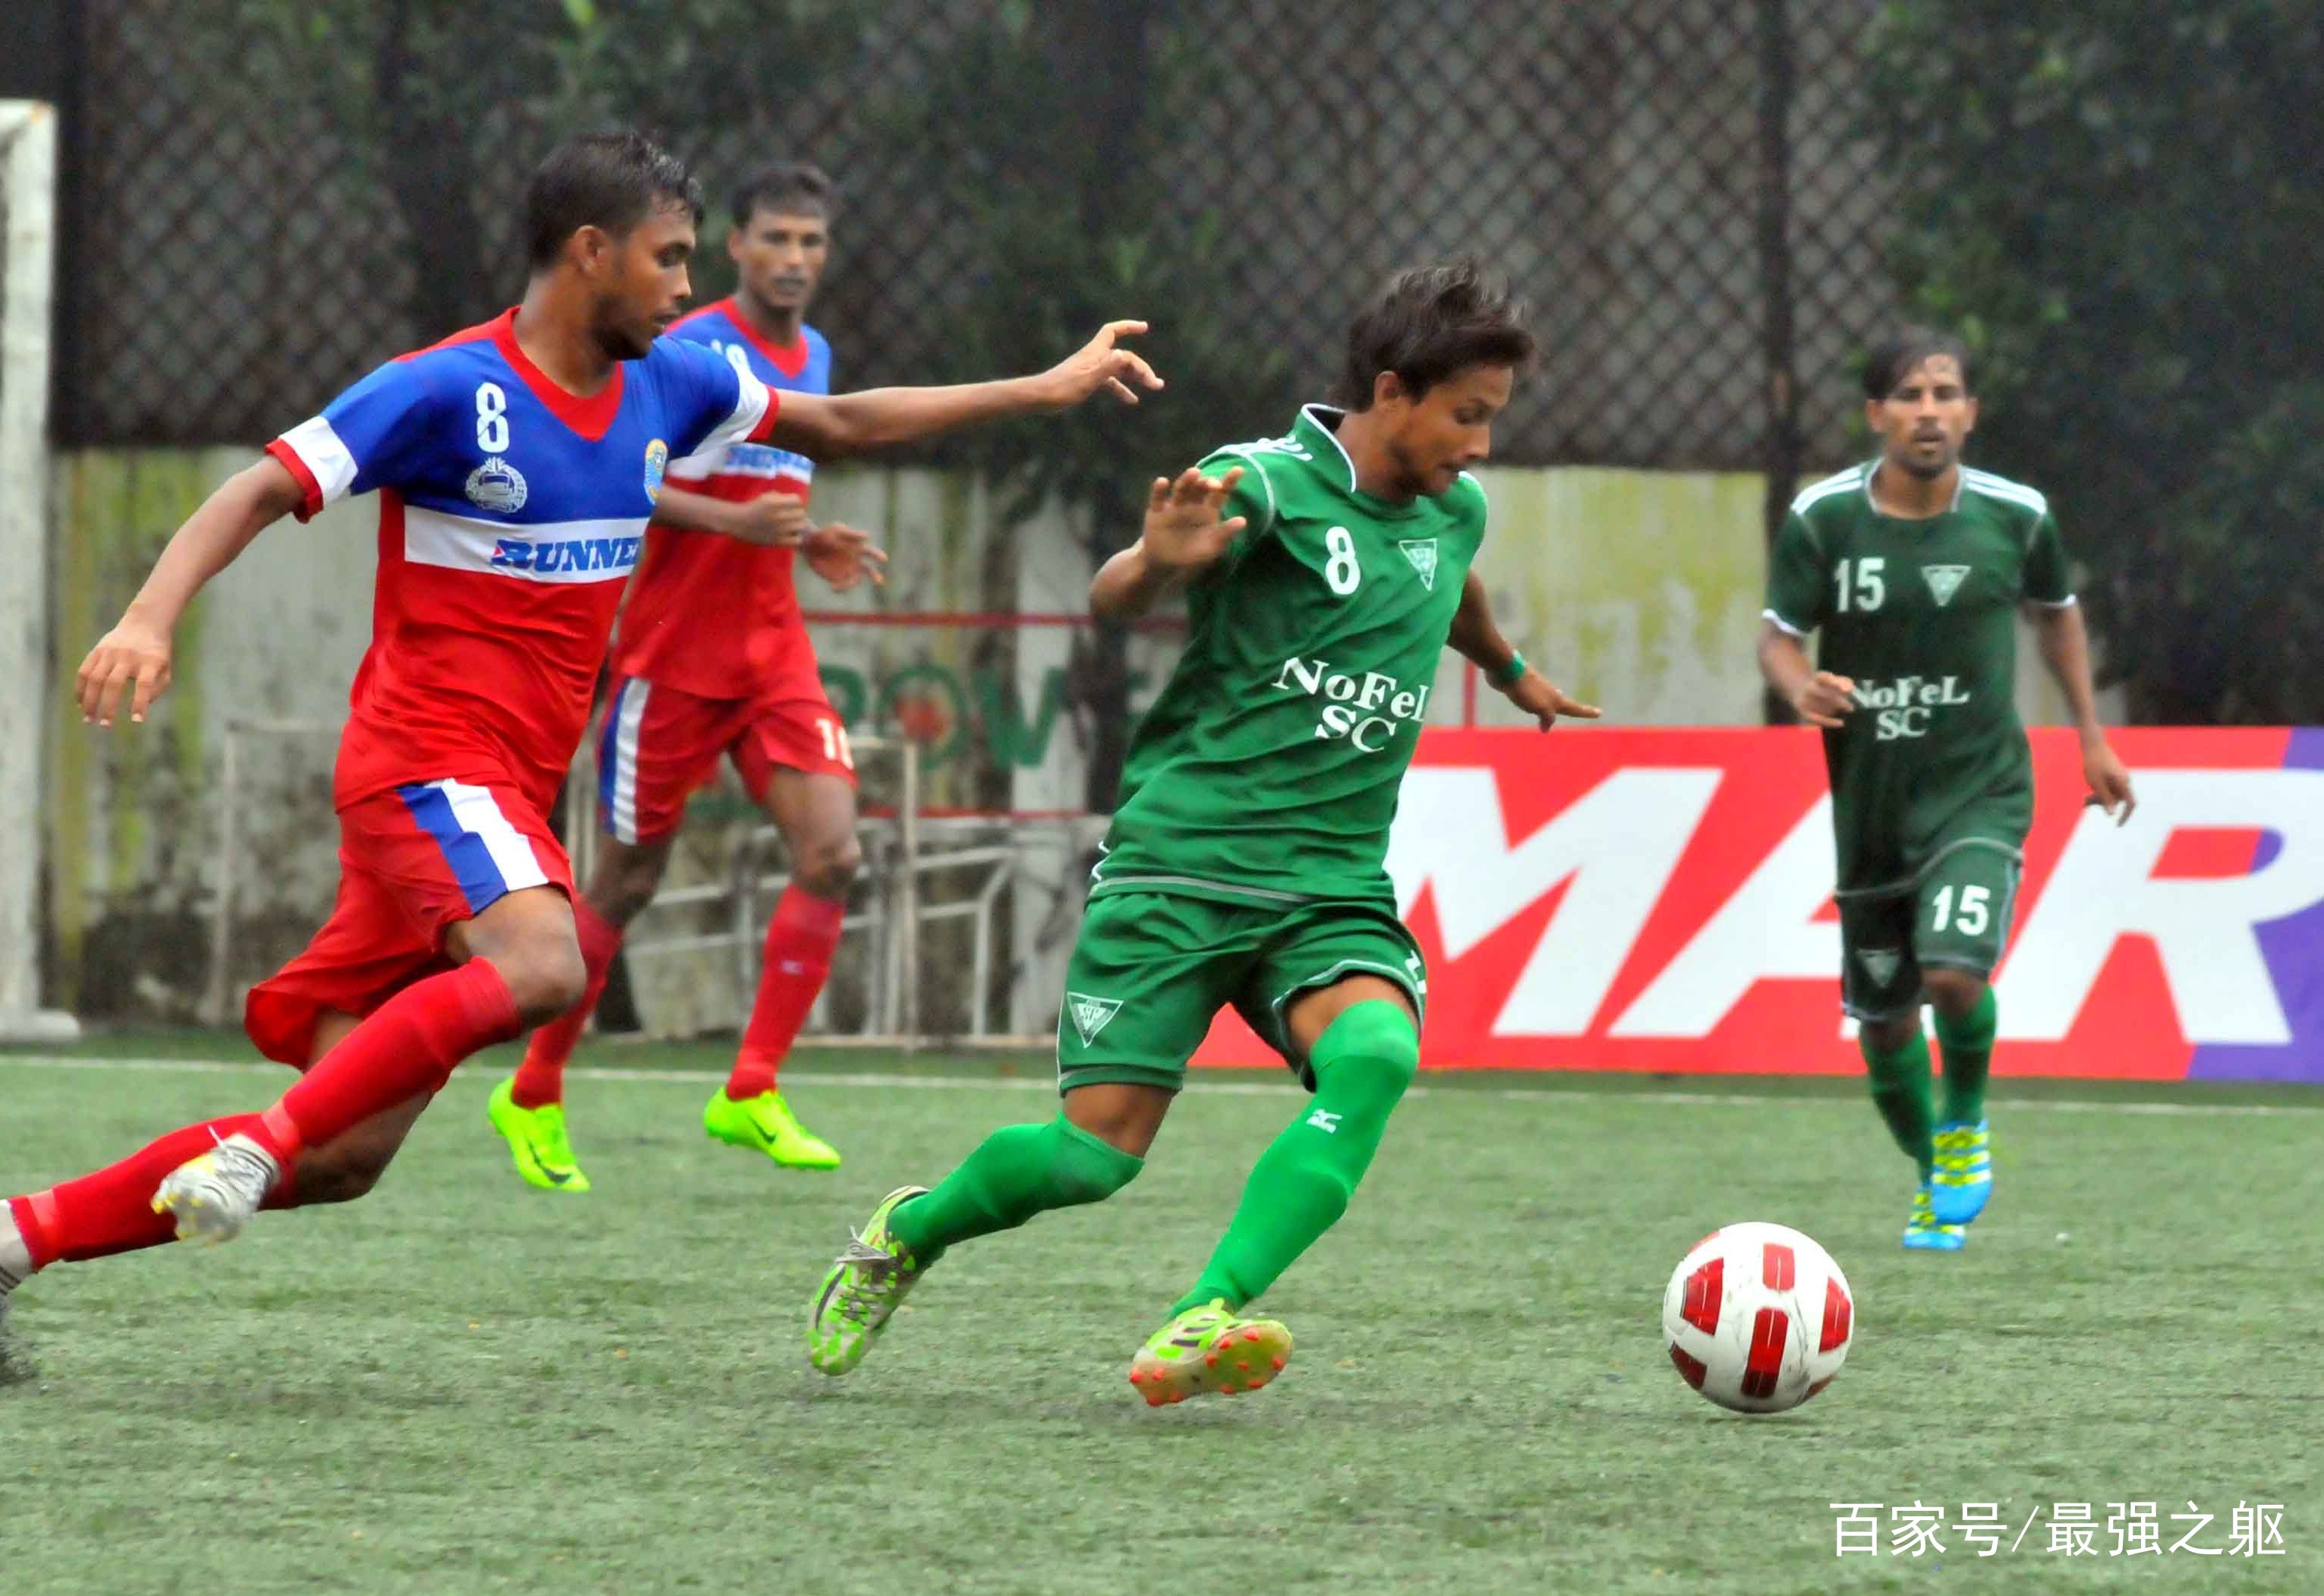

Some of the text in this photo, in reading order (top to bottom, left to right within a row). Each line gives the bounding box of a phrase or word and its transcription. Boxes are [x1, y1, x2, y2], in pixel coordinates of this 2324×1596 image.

[475, 382, 509, 453] 8
[1325, 526, 1361, 595] 8
[1834, 557, 1885, 613] 15
[1315, 705, 1397, 753] SC
[1876, 706, 1931, 741] SC
[1931, 885, 1991, 936] 15
